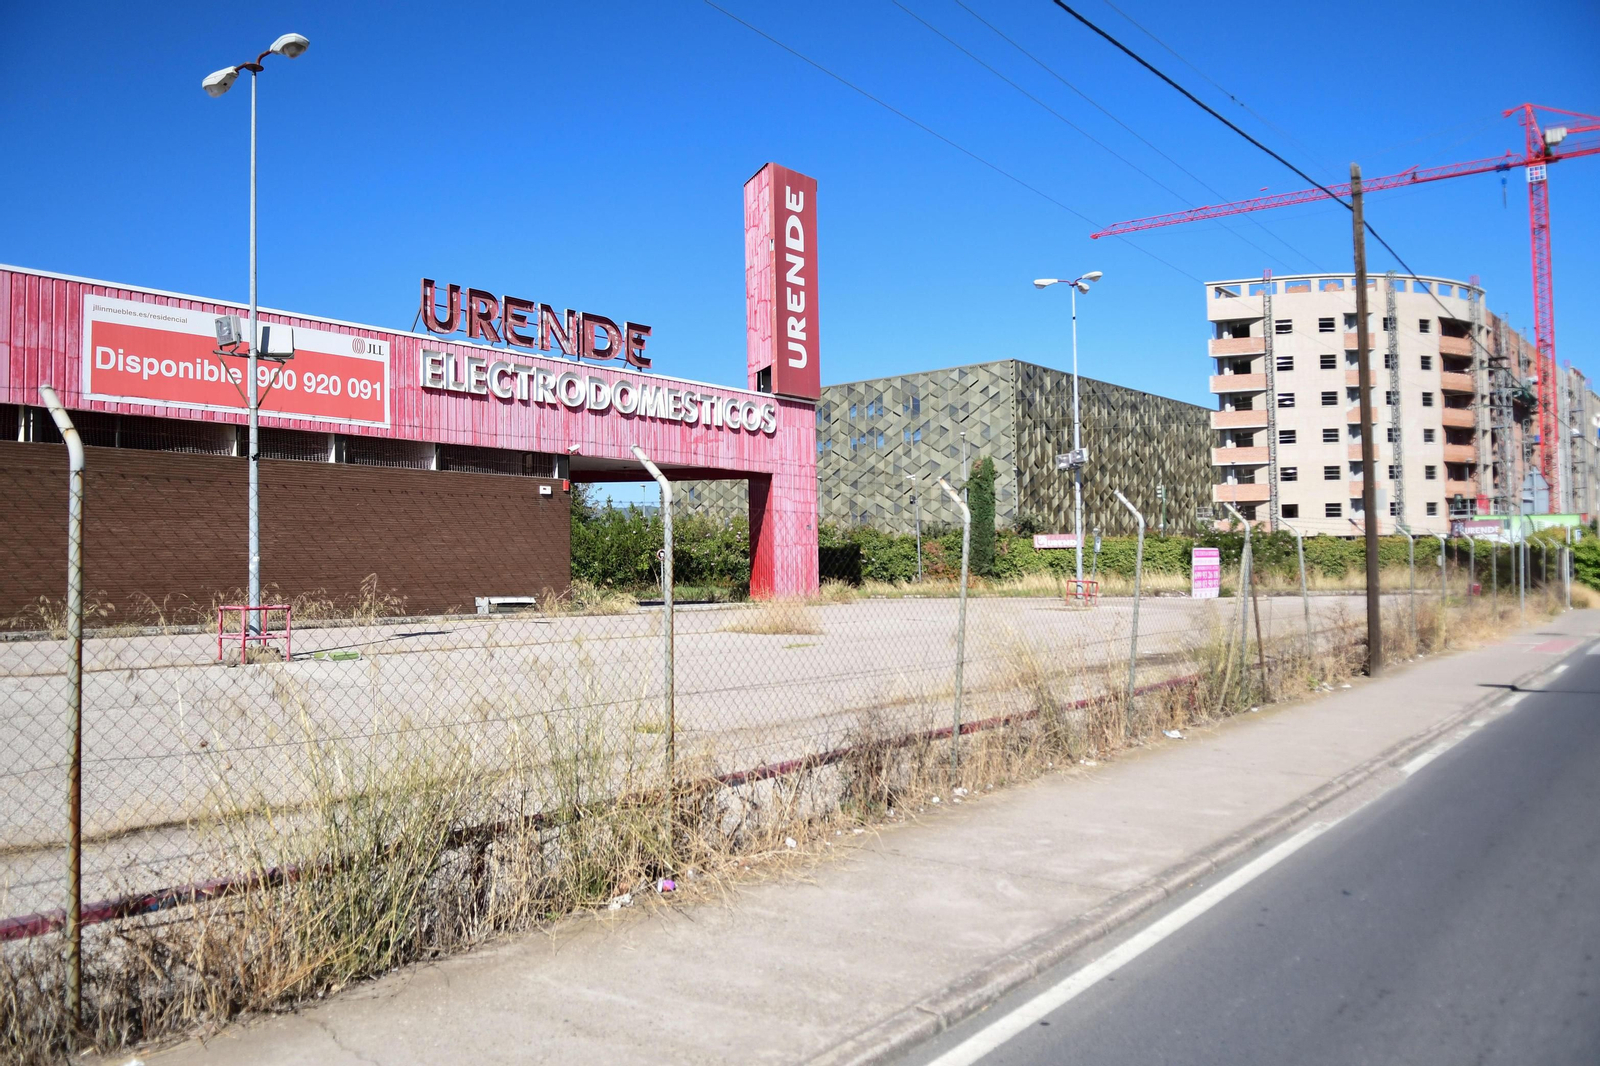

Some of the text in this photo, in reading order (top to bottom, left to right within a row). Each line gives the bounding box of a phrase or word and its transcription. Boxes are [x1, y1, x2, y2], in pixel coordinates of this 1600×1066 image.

[786, 185, 807, 369] URENDE
[92, 304, 188, 324] jllinmuebles.es/residencial
[420, 277, 652, 369] URENDE
[366, 343, 385, 356] JLL
[95, 346, 381, 401] Disponible 900 920 091
[420, 348, 777, 434] ELECTRODOMESTICOS
[1047, 539, 1078, 547] UREND
[1465, 526, 1499, 534] URENDE
